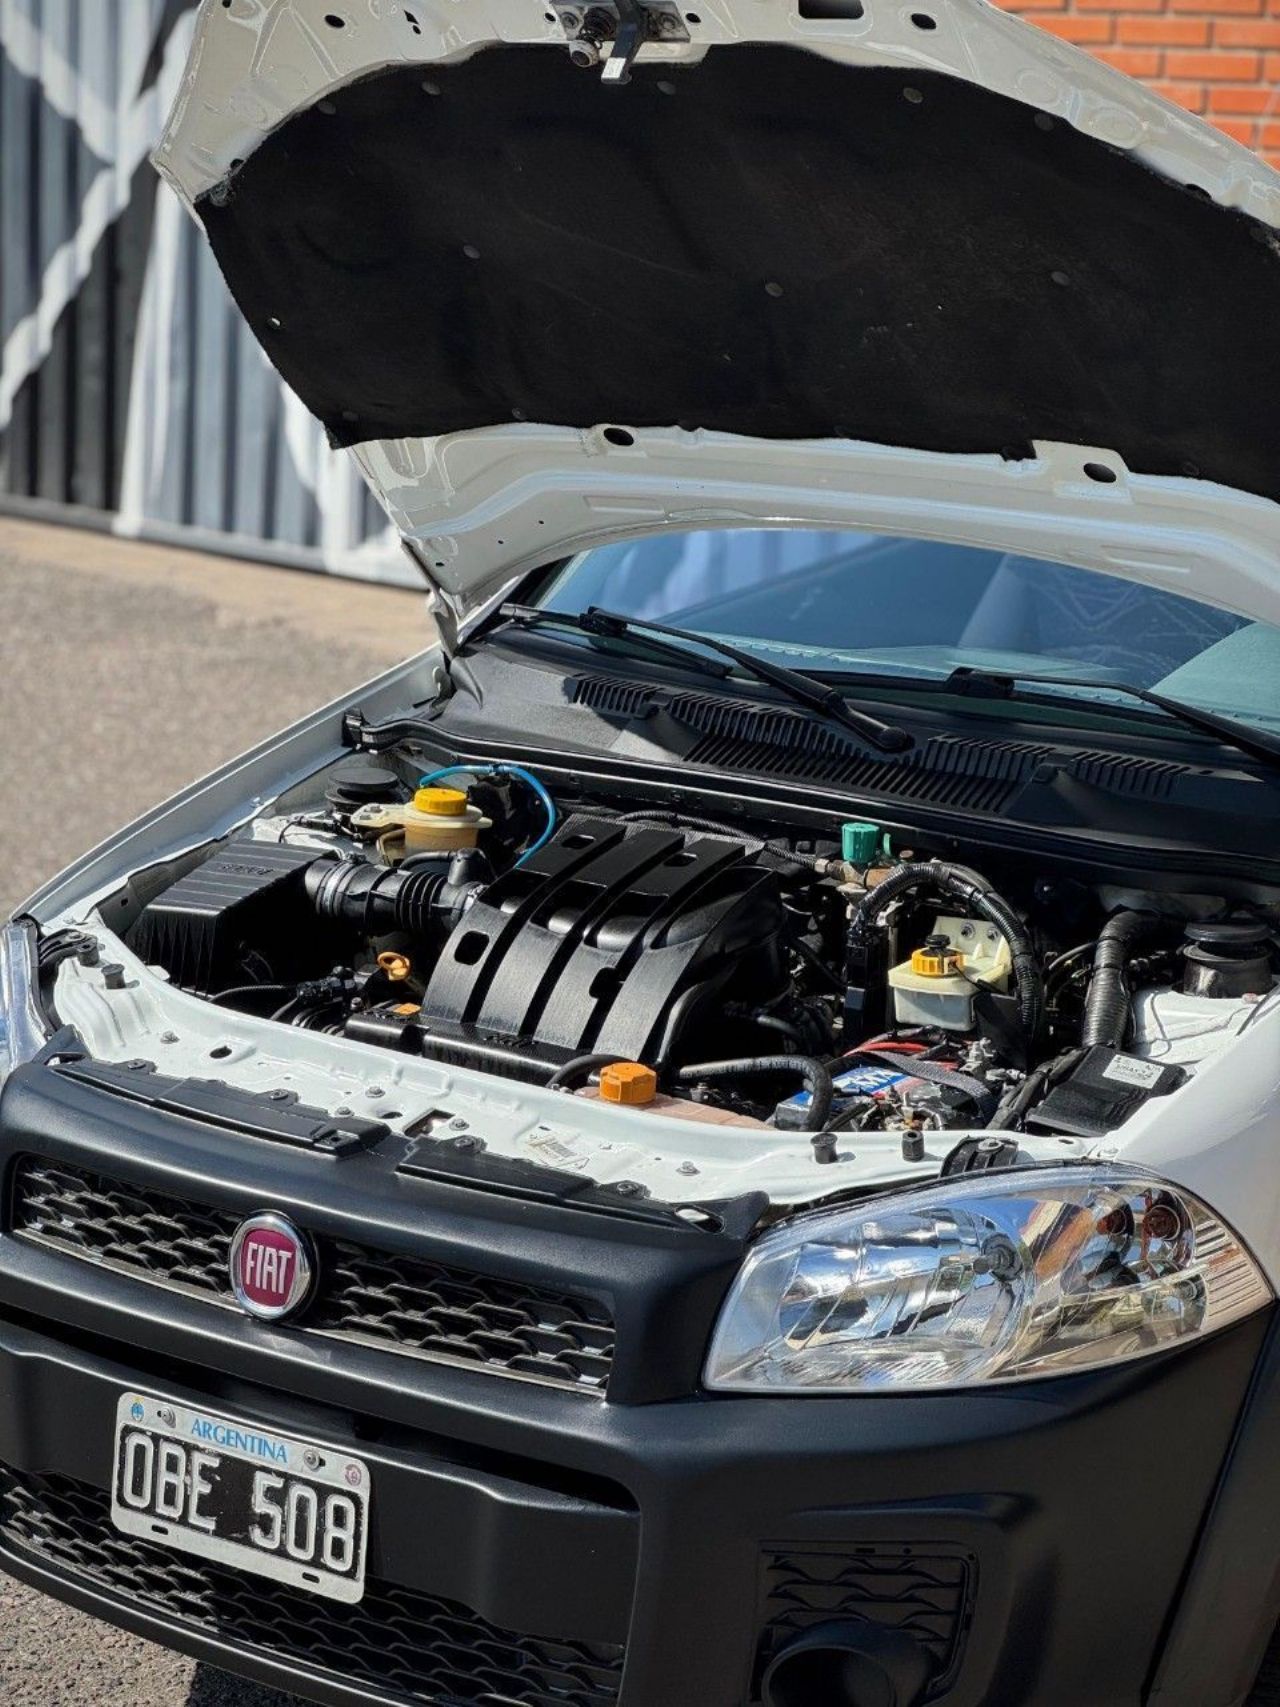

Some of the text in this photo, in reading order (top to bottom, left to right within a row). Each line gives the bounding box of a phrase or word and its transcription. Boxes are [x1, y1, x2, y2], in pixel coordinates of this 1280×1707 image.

[245, 1242, 292, 1294] FIAT
[191, 1418, 288, 1463] ARGENTINA
[123, 1431, 356, 1571] OBE 508
